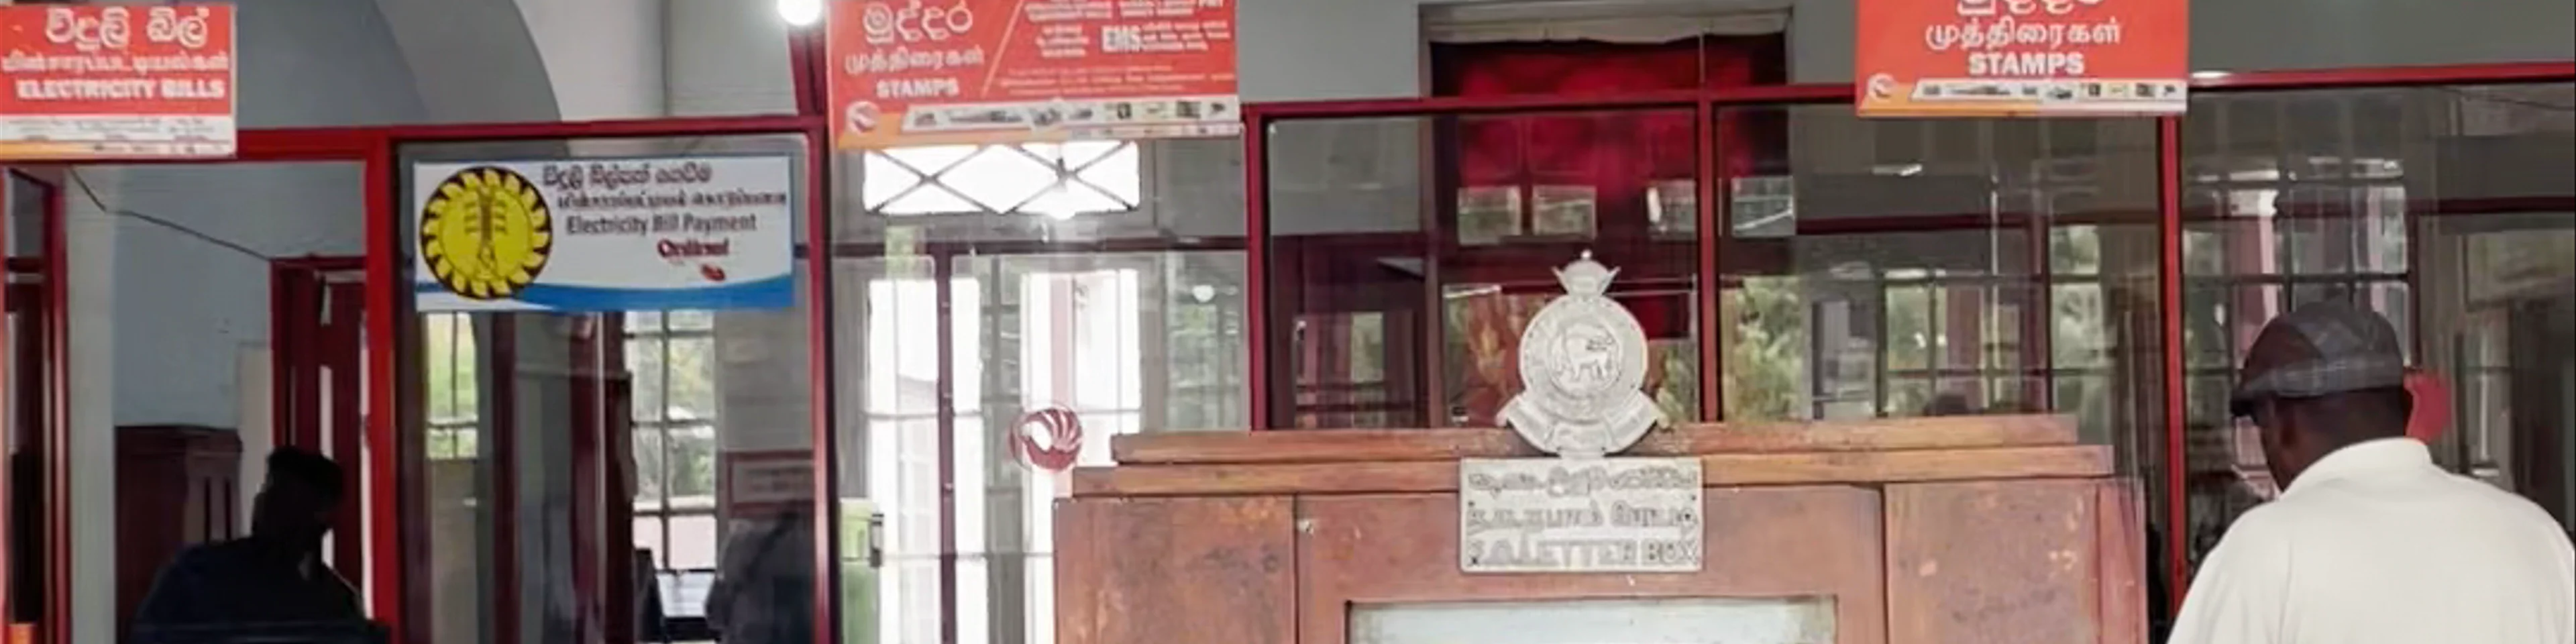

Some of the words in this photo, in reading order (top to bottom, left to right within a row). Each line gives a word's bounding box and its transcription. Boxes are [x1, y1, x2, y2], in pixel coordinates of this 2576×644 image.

[1925, 16, 2121, 50] முத்திரைகள்
[1968, 51, 2084, 75] STAMPS
[15, 78, 157, 99] ELECTRICITY
[161, 77, 226, 99] BILLS
[876, 77, 960, 99] STAMPS
[566, 214, 648, 236] Electricity
[653, 213, 680, 233] Bill
[683, 213, 757, 236] Payment
[1641, 538, 1699, 567] BOX
